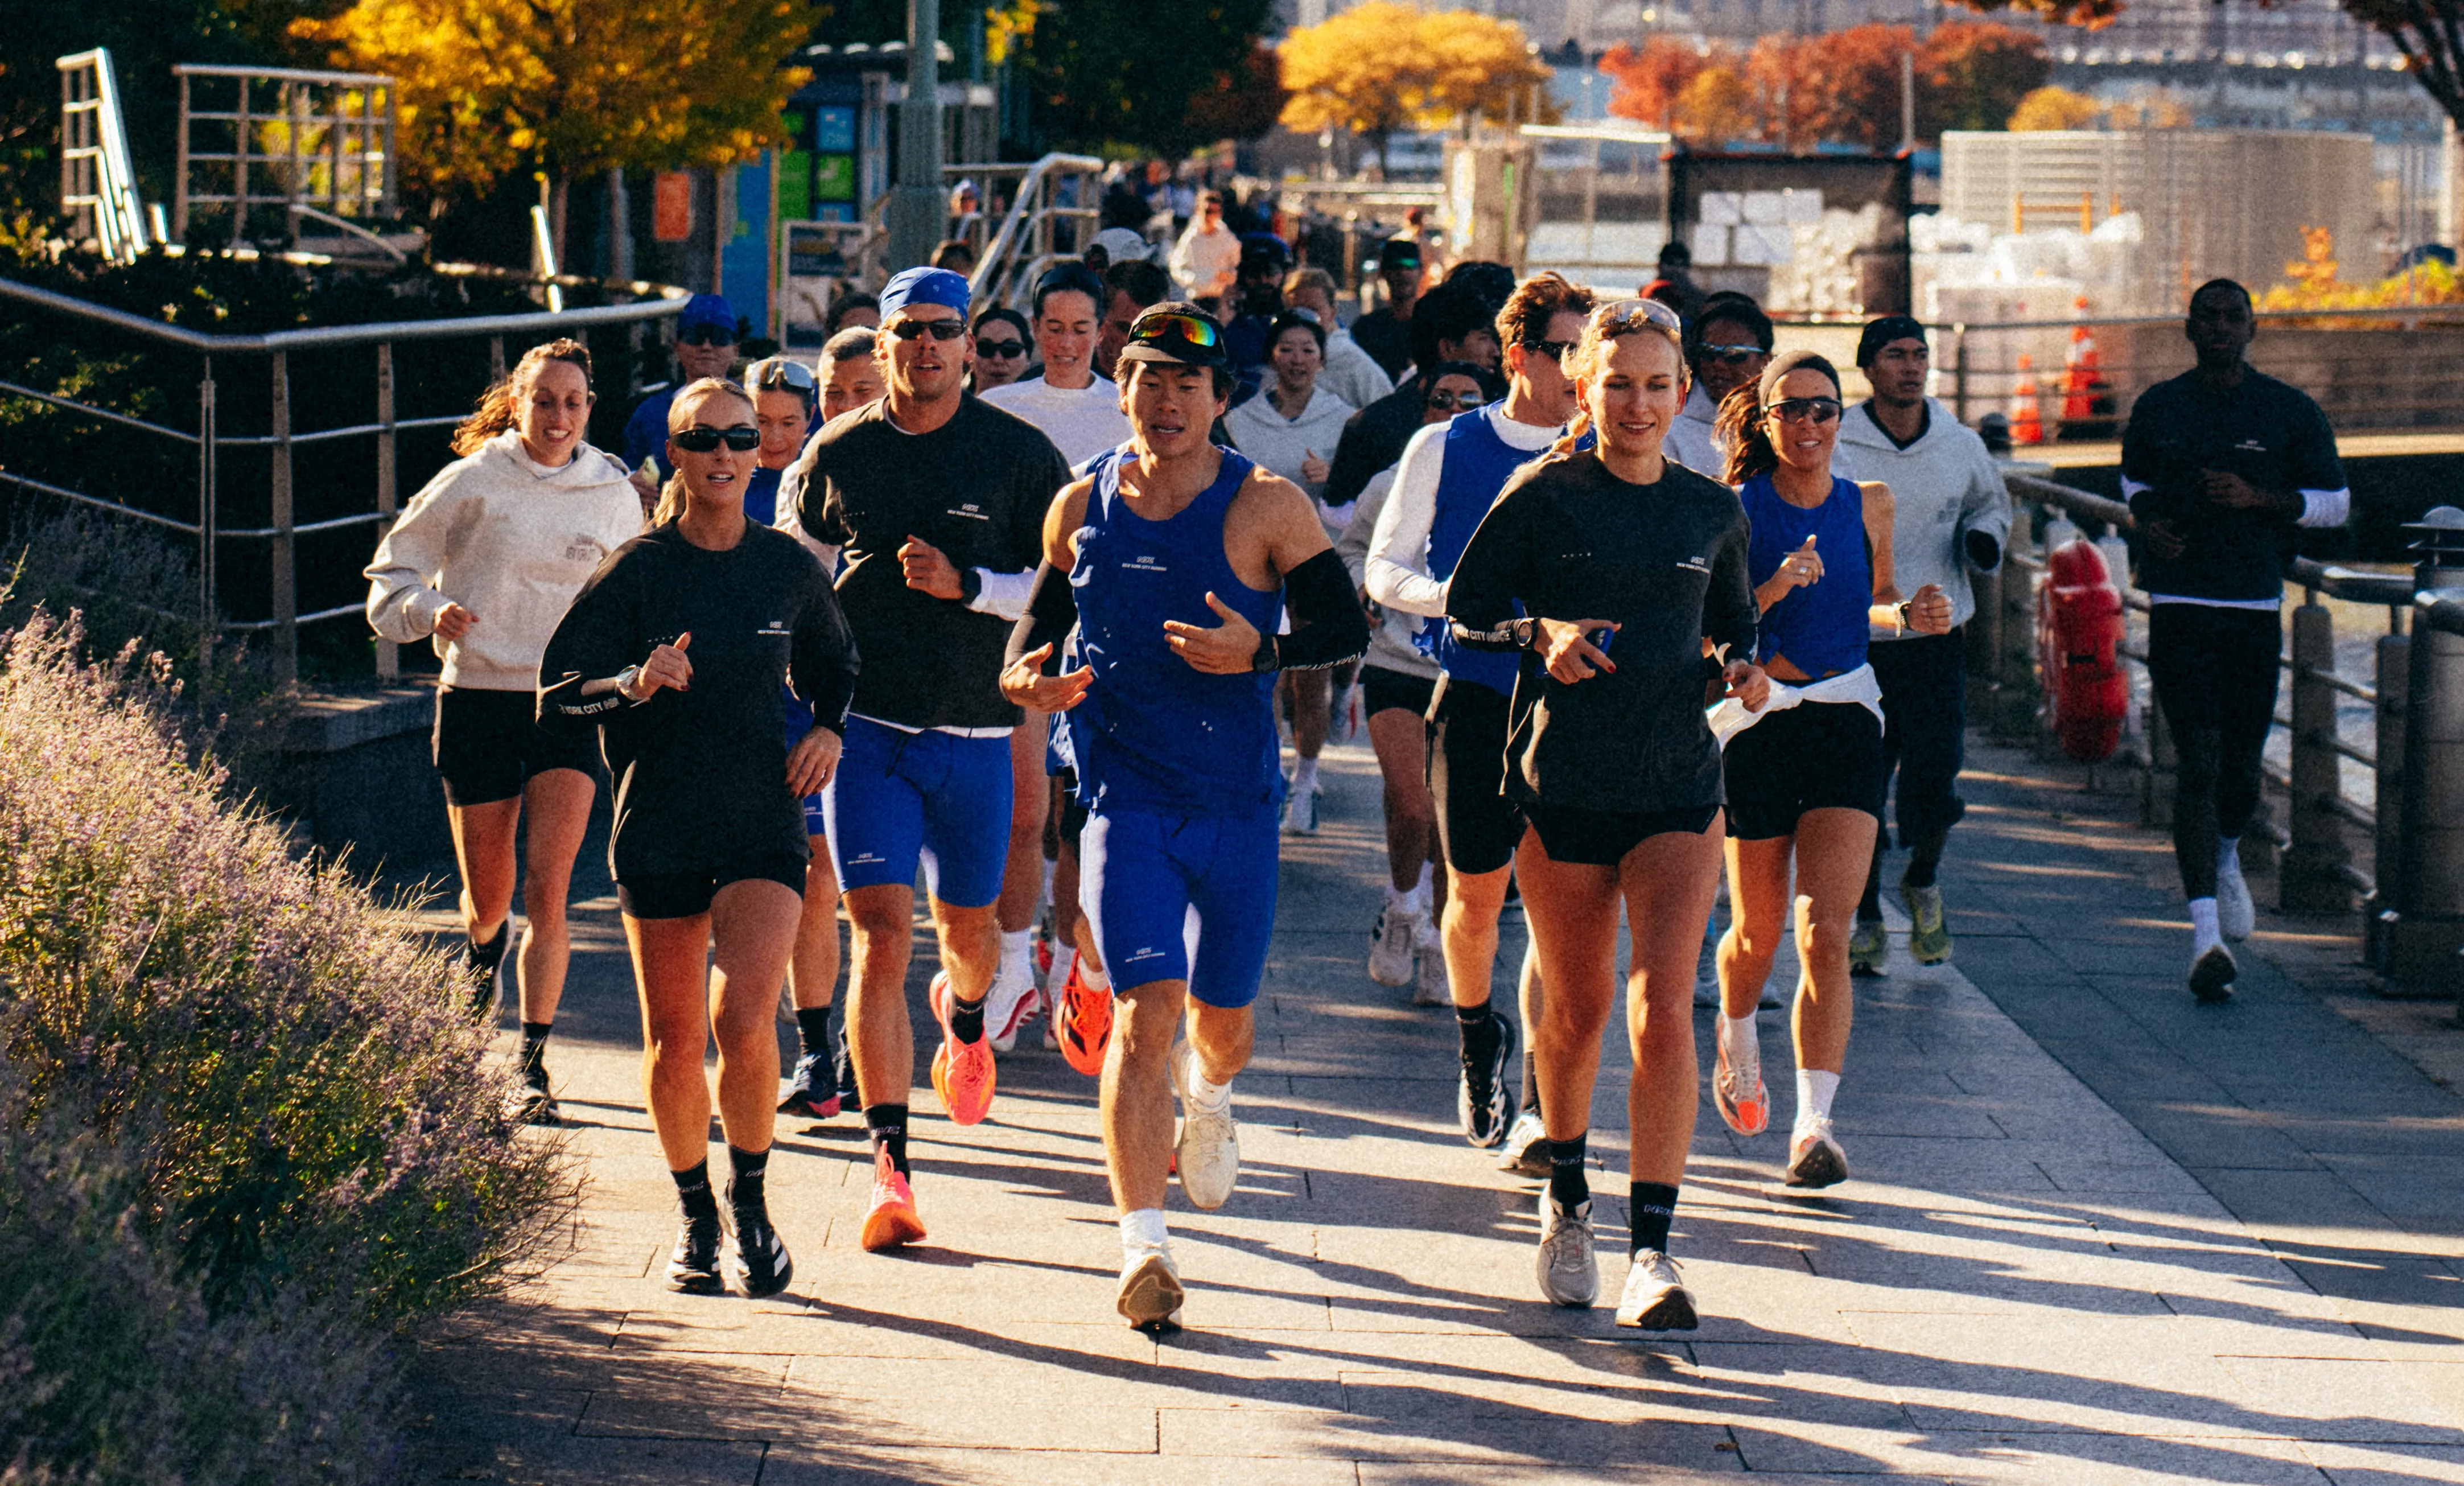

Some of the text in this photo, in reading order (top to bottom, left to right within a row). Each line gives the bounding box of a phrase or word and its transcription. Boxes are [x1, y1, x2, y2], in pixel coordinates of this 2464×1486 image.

[1469, 629, 1486, 641] CITY
[1332, 651, 1361, 667] YORK
[1309, 661, 1334, 671] CITY
[583, 701, 603, 714] CITY
